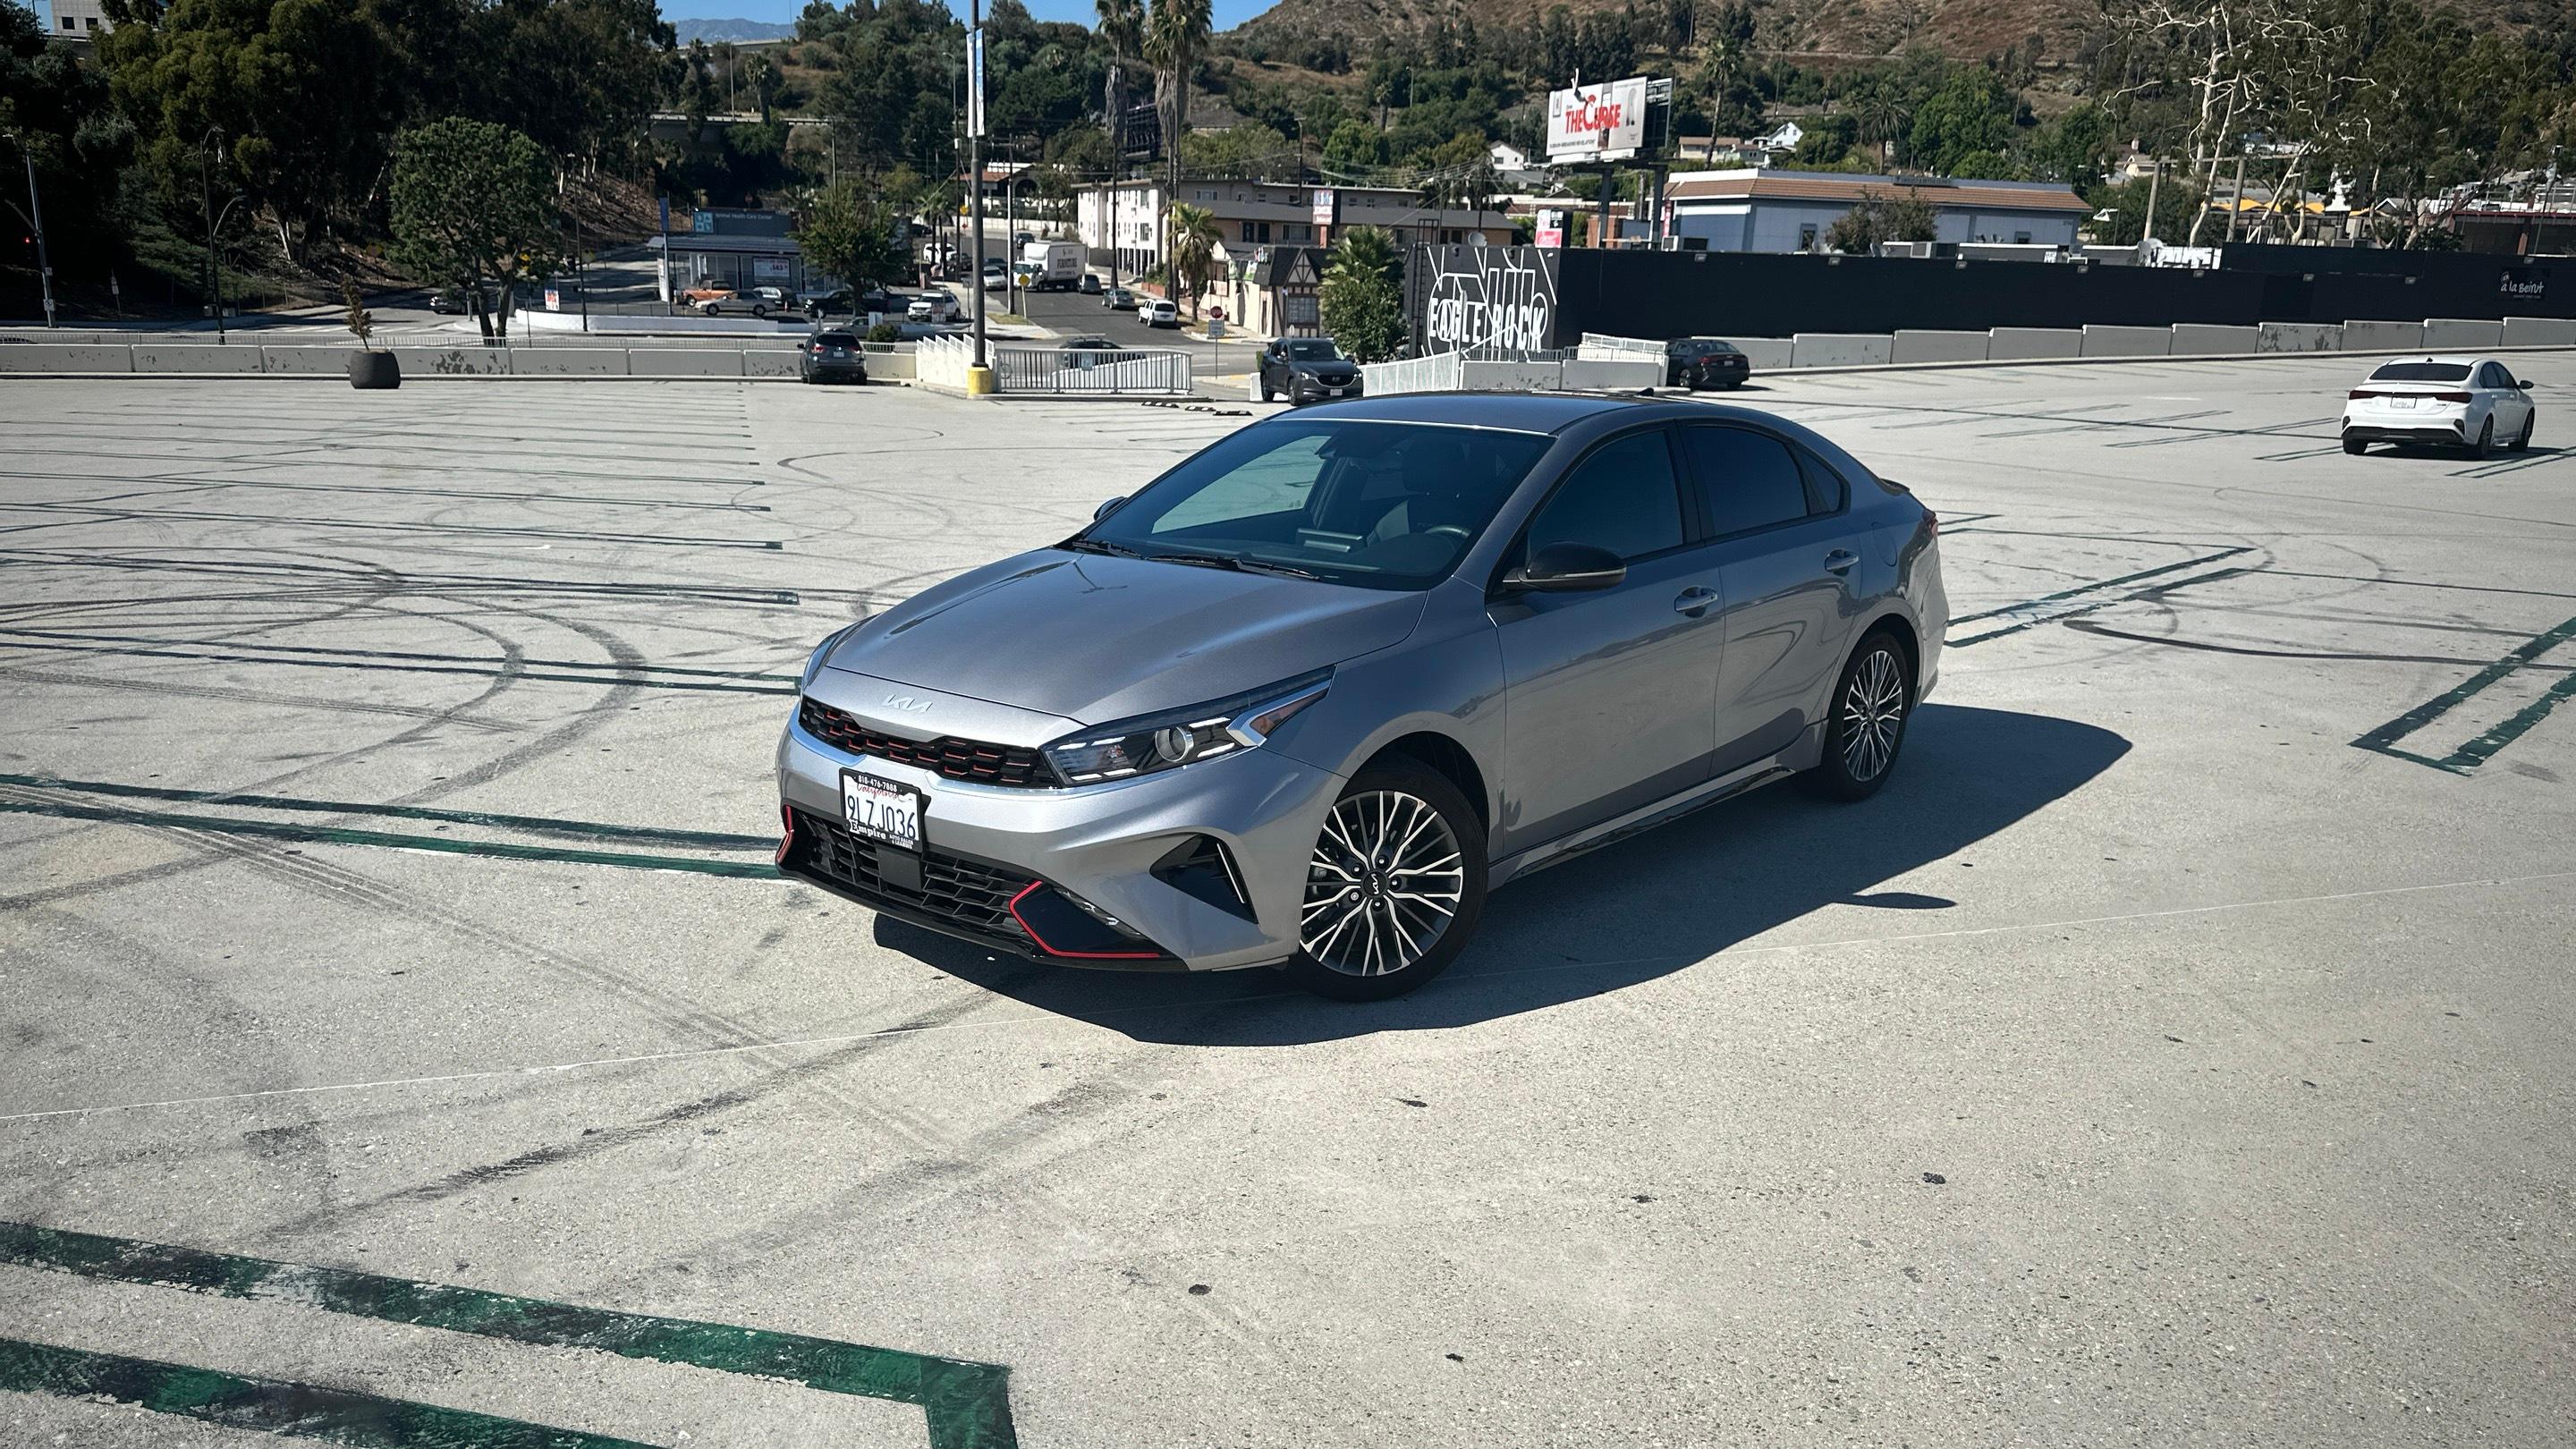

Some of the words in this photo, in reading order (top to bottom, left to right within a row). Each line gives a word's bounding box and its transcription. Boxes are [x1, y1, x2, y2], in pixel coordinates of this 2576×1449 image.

[1565, 109, 1584, 134] THE
[2509, 281, 2518, 292] la
[2519, 281, 2544, 293] Beirut
[1429, 298, 1484, 343] EAGLE
[1491, 303, 1545, 353] ROCK
[882, 693, 934, 714] KIA
[858, 775, 898, 792] 818-476-7888
[847, 795, 916, 839] 9LZJ036
[849, 818, 886, 840] Empire
